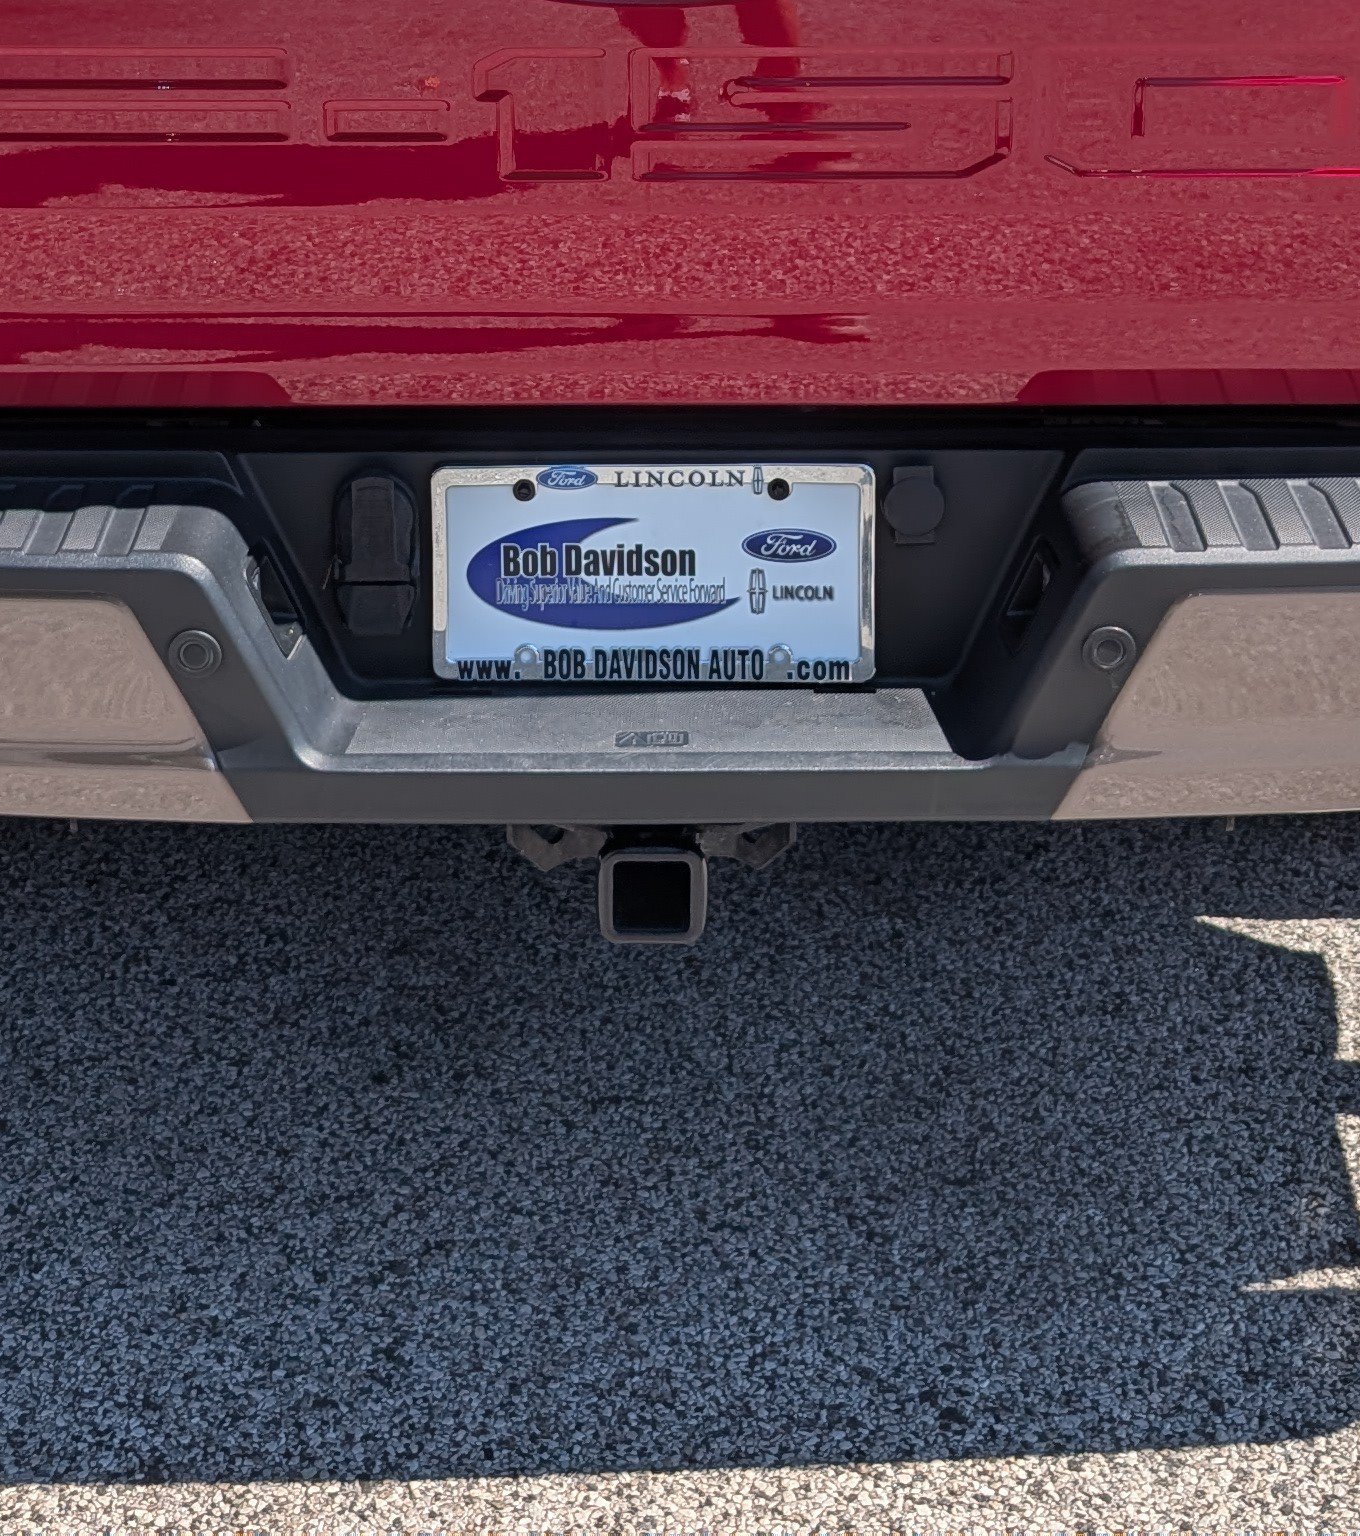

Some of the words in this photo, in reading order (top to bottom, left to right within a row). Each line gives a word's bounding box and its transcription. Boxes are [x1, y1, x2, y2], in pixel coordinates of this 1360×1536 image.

[613, 469, 746, 489] LINCOLN
[759, 533, 820, 558] Ford
[502, 543, 557, 577] Bob
[564, 543, 696, 577] Davidson
[495, 577, 529, 611] Driving
[530, 577, 567, 611] Superior
[593, 577, 612, 604] And
[613, 577, 655, 604] Customer
[656, 578, 688, 604] Service
[689, 577, 727, 604] Forward
[772, 584, 835, 601] LINCOLN
[457, 660, 521, 680] www.
[544, 650, 585, 680] BOB
[595, 649, 700, 680] DAVIDSON
[708, 650, 765, 680] AUTO
[786, 658, 851, 681] .com
